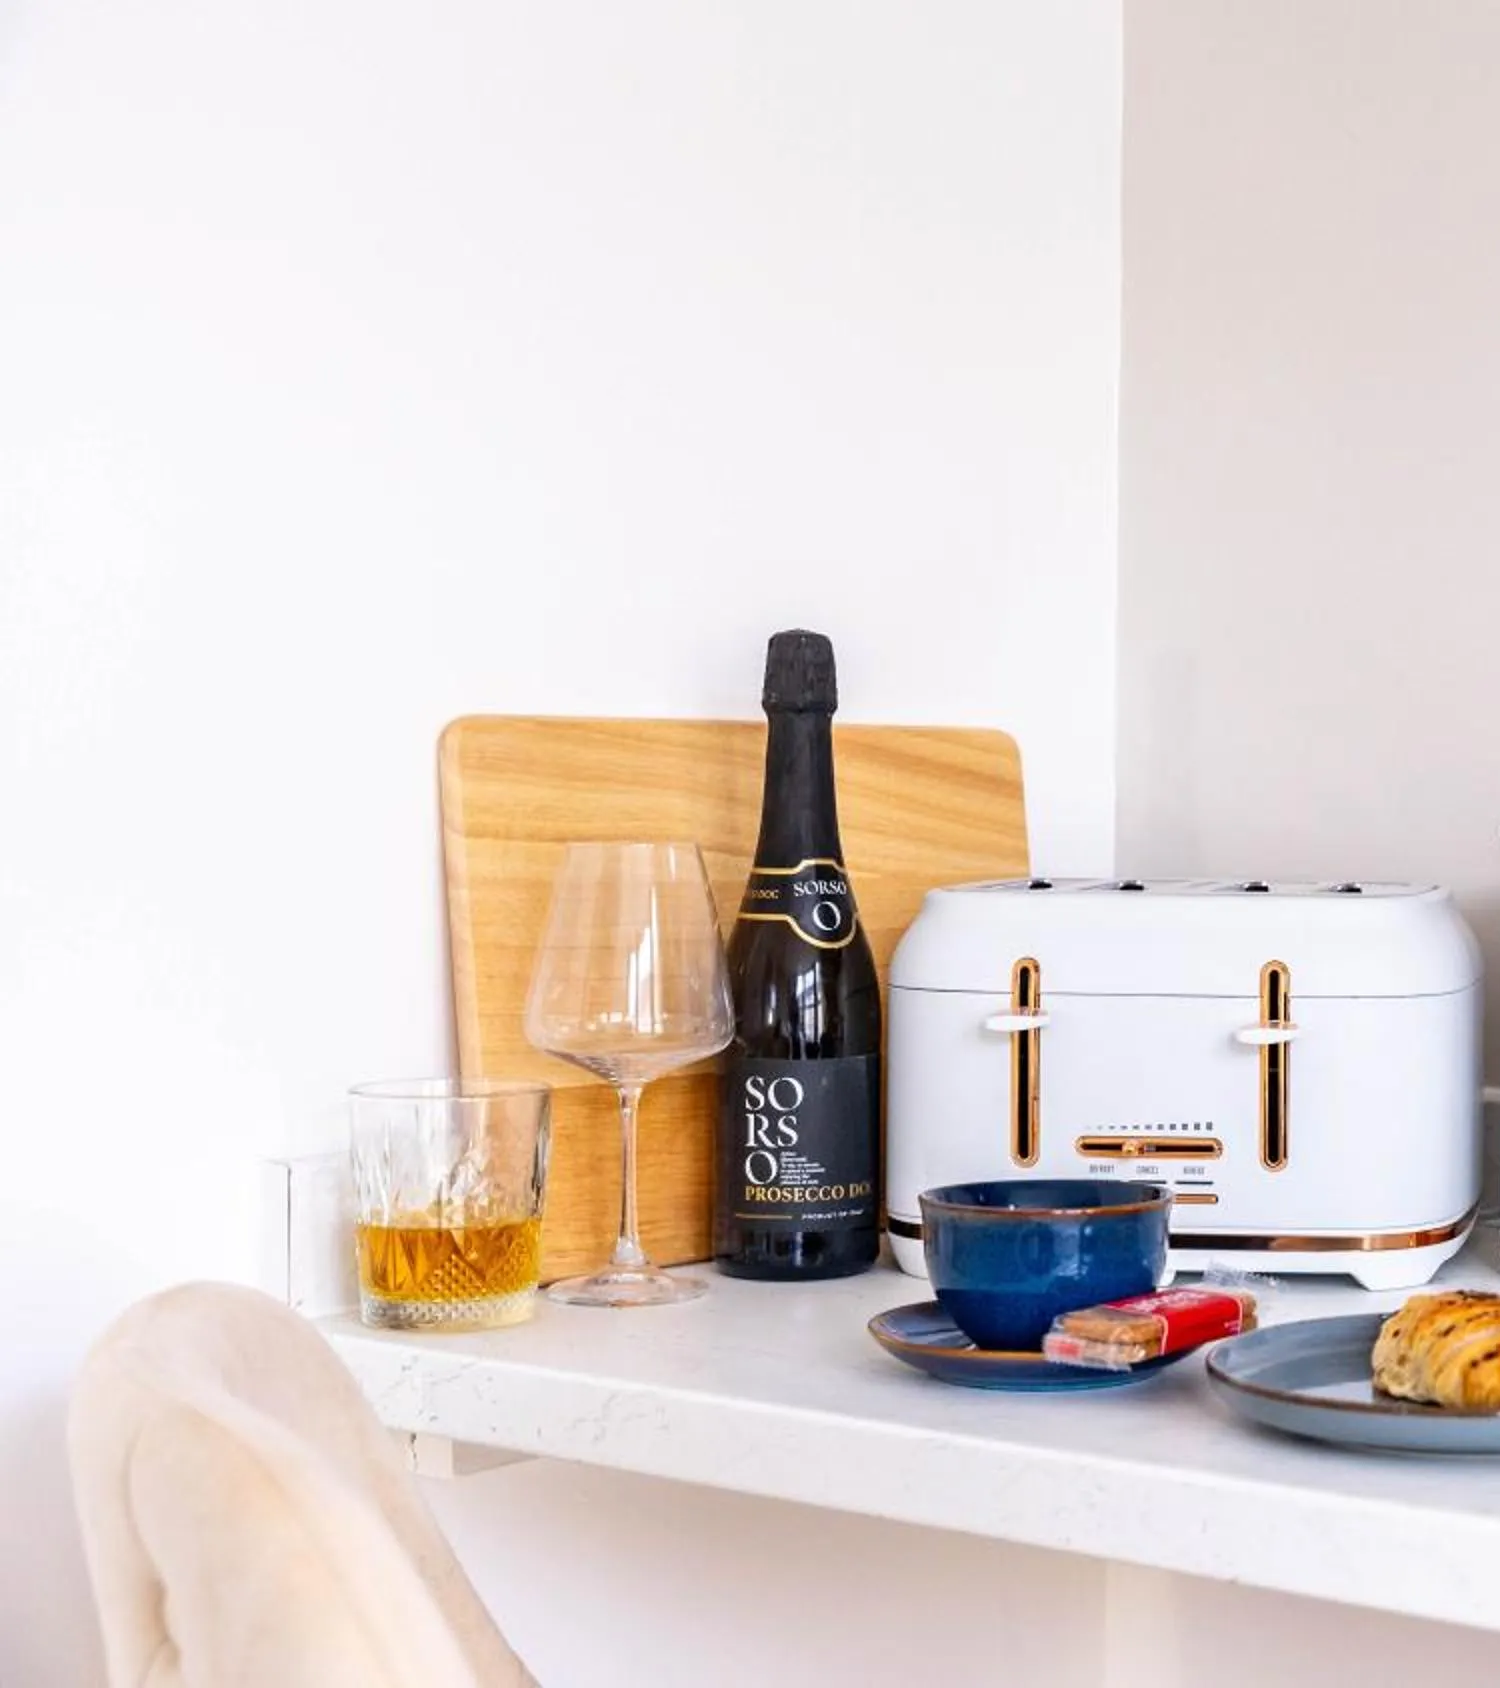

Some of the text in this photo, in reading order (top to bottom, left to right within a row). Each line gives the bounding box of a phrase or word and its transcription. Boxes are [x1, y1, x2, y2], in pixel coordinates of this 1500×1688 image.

[793, 880, 847, 897] SORSO
[812, 901, 841, 931] O
[745, 1075, 804, 1111] SO
[744, 1113, 799, 1148] RS
[745, 1150, 778, 1185] O
[745, 1186, 845, 1202] PROSECCO
